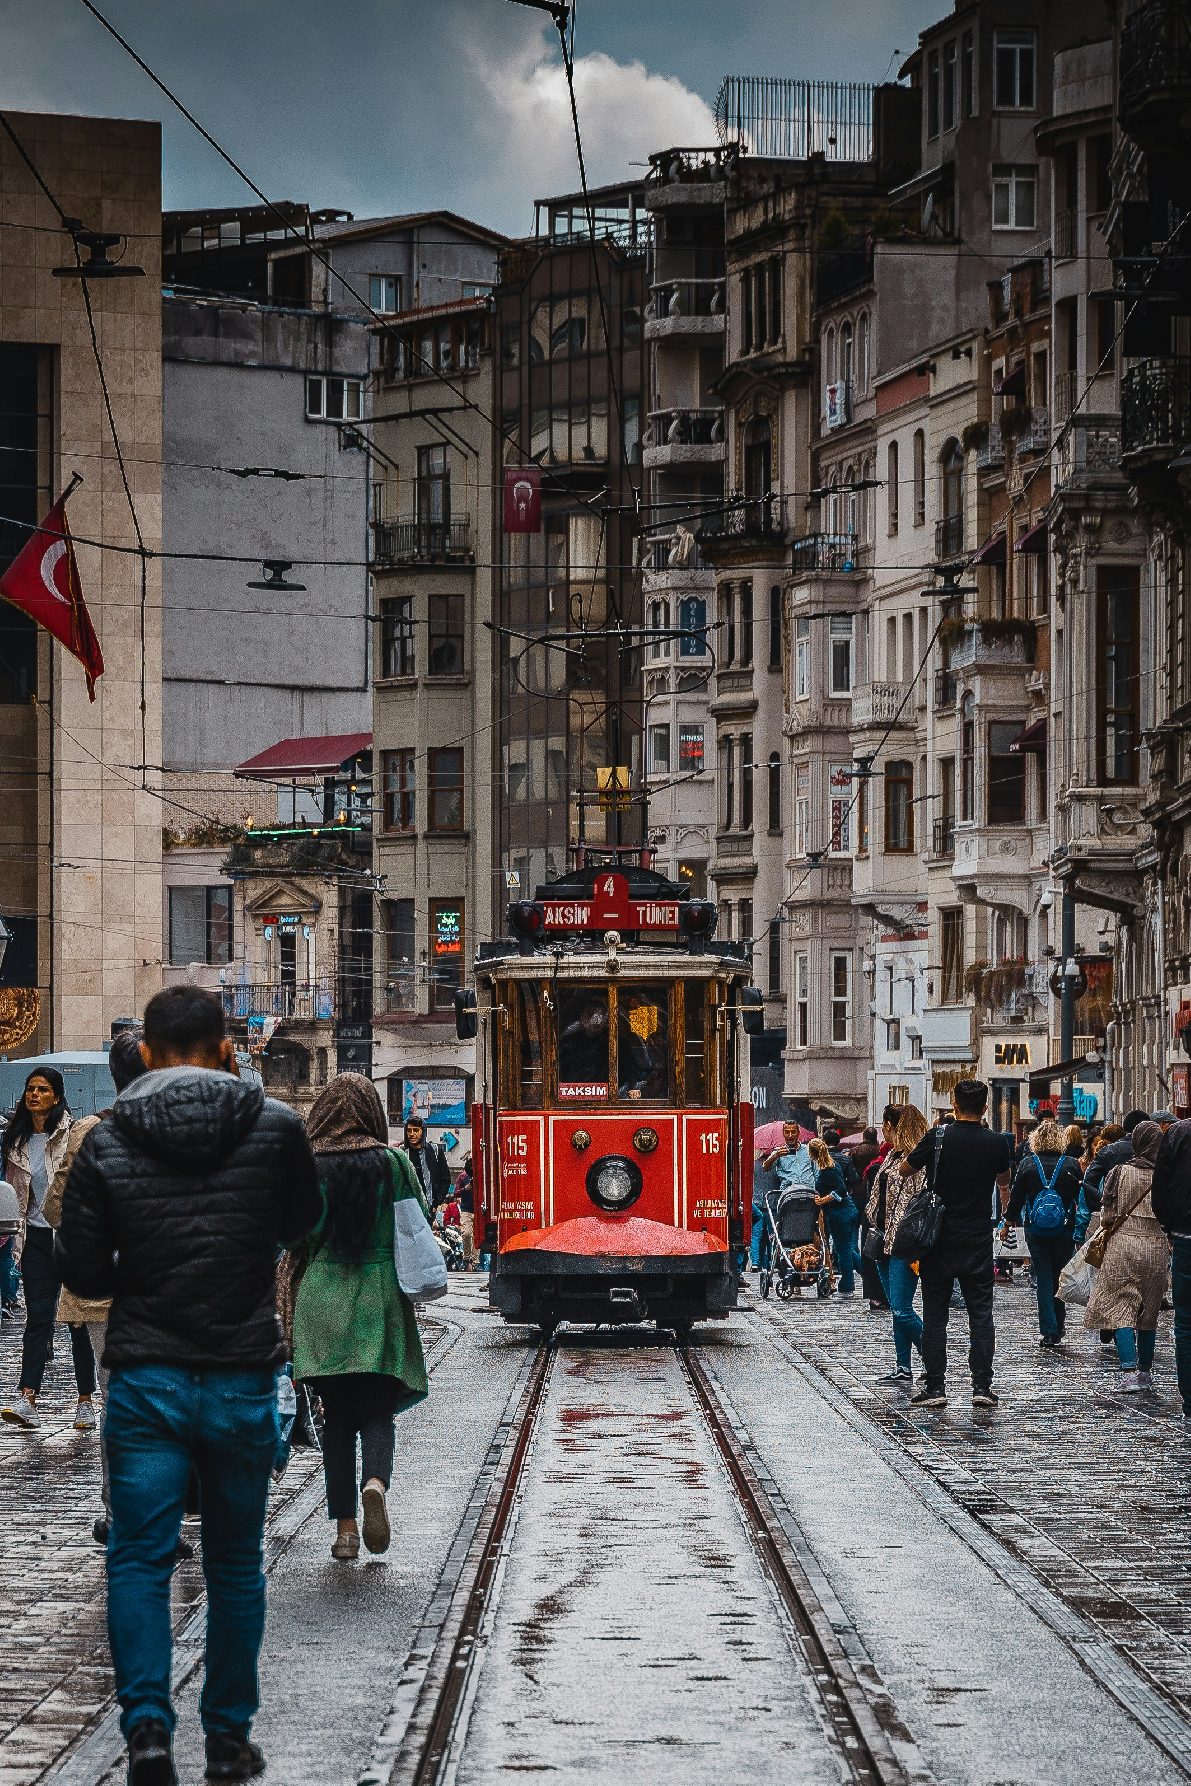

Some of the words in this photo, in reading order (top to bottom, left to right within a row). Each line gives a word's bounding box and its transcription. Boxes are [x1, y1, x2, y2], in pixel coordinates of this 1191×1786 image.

[603, 877, 614, 896] 4
[560, 1086, 607, 1097] TAKSİM
[507, 1134, 527, 1156] 115
[699, 1132, 720, 1154] 115
